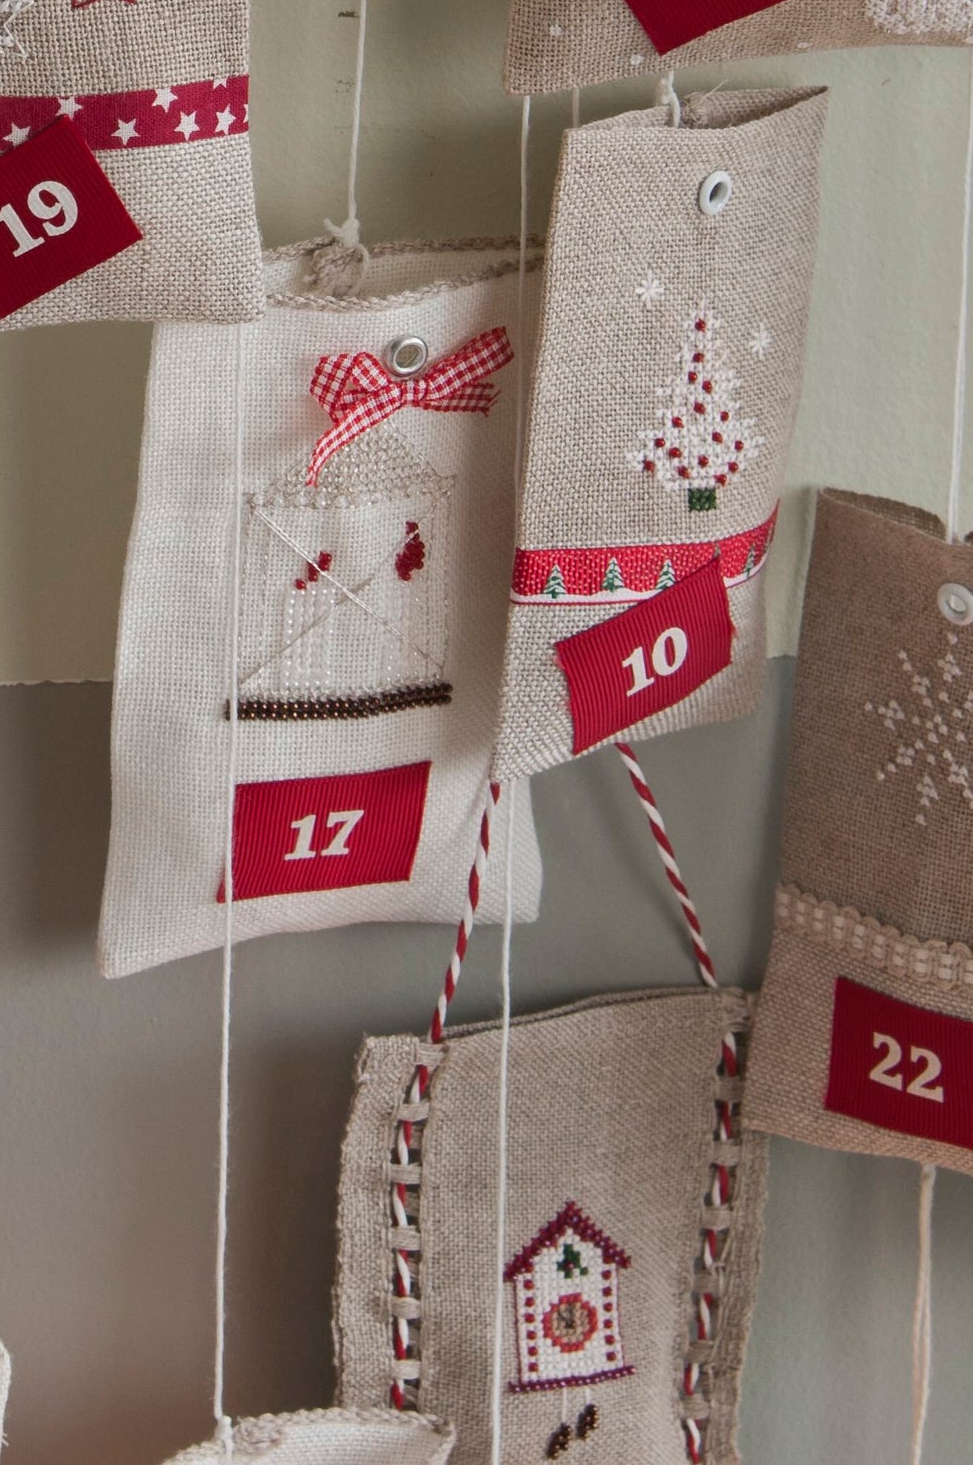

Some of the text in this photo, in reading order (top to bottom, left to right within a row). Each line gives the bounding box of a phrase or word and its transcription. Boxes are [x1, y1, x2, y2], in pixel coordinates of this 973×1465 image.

[622, 627, 688, 697] 10
[284, 809, 364, 861] 17
[868, 1031, 945, 1103] 22
